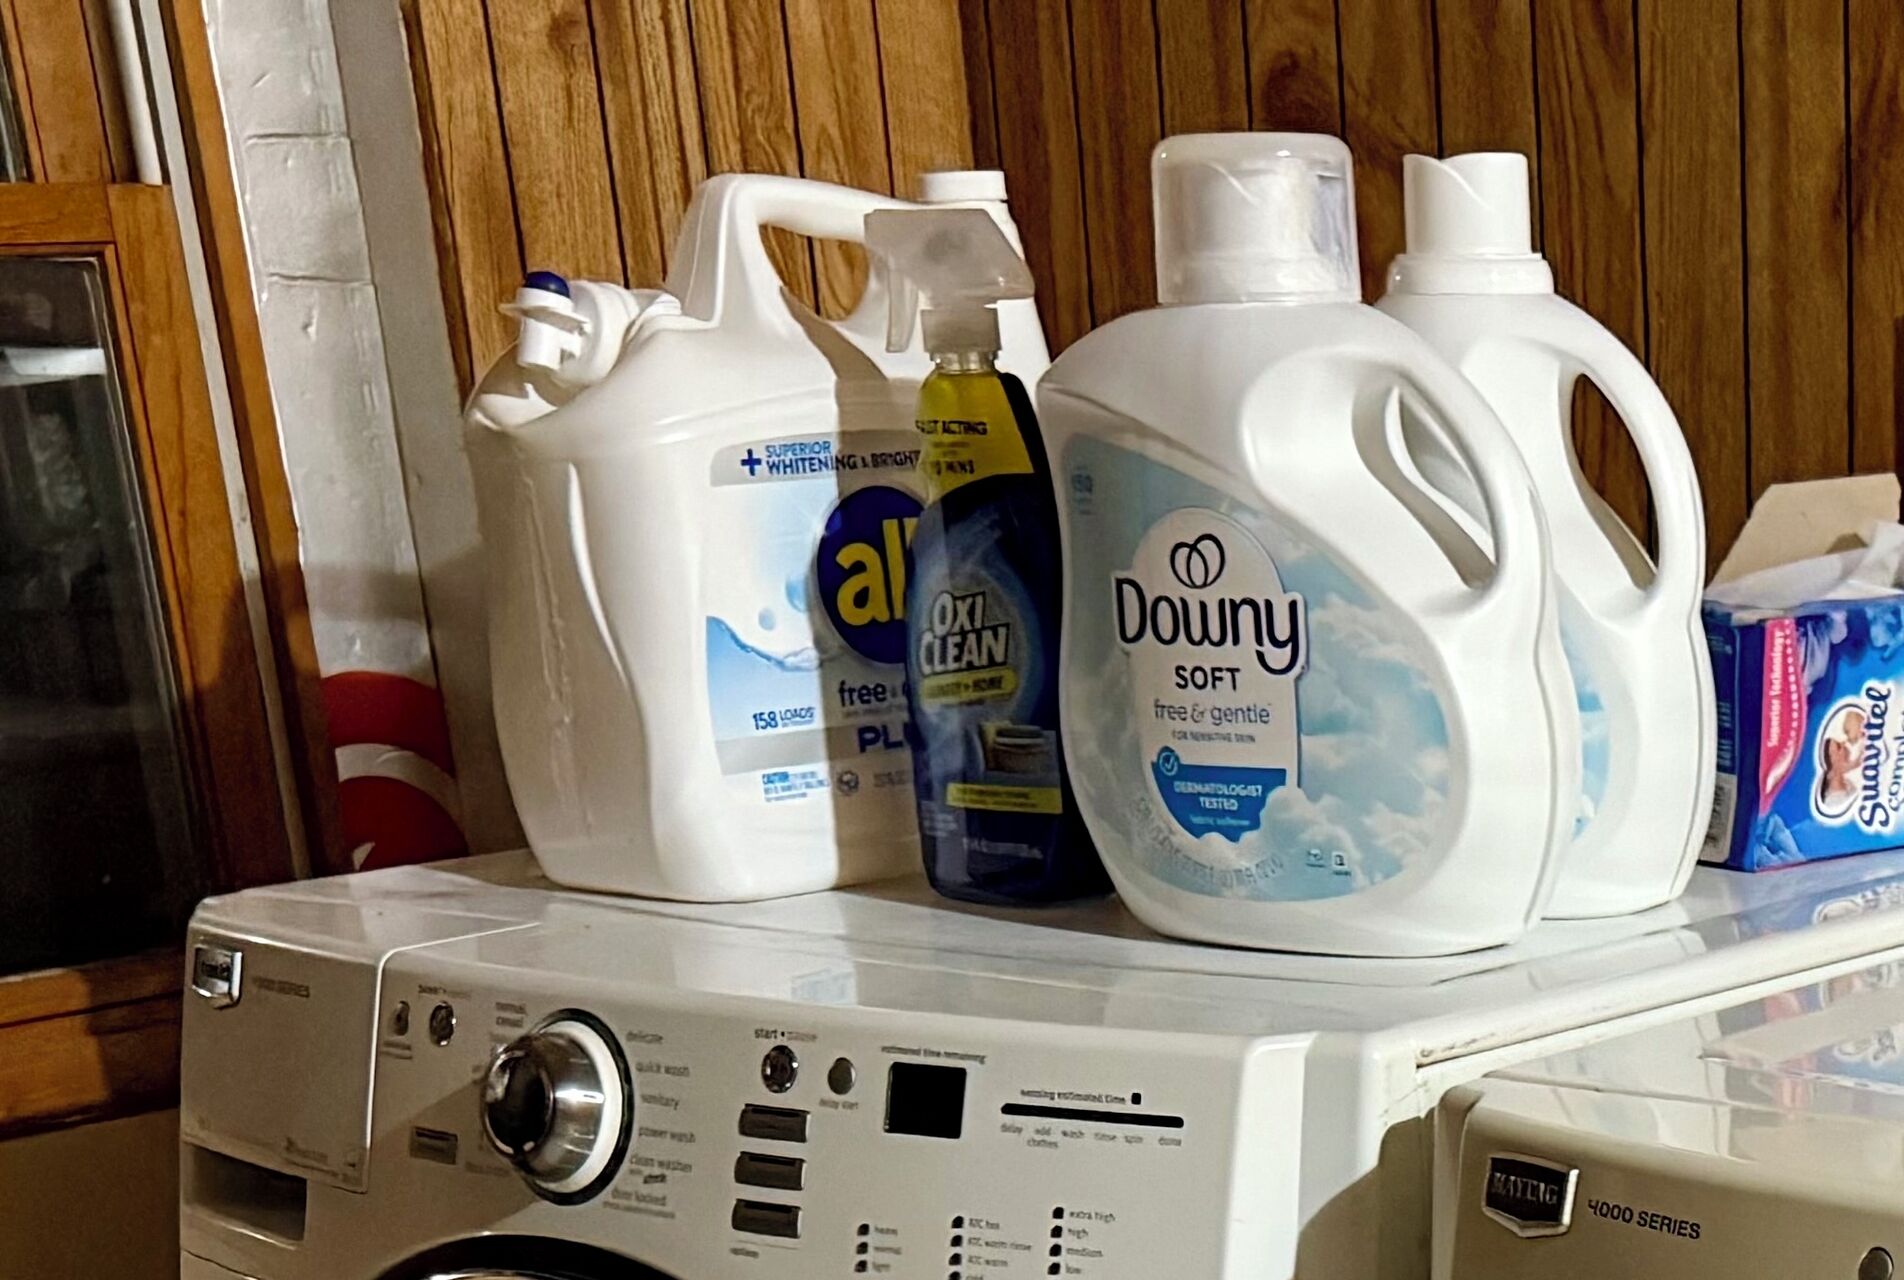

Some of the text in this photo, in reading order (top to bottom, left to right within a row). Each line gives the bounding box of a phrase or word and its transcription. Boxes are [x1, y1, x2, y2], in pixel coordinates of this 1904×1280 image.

[765, 441, 832, 458] SUPERIOR
[765, 453, 858, 476] WHITENING
[931, 590, 986, 637] OXI
[1114, 577, 1300, 676] Downy
[920, 624, 1009, 677] CLEAN
[1174, 664, 1241, 691] SOFT
[1767, 629, 1785, 748] Superior Technology
[838, 679, 887, 708] free
[752, 710, 779, 731] 158
[1154, 699, 1268, 727] free & gentle
[1858, 685, 1892, 828] Suavitel
[1173, 780, 1263, 798] DERMATOLOGIST
[1199, 797, 1239, 811] TESTED
[755, 1028, 778, 1040] start
[1492, 1172, 1560, 1205] MAYTAG
[1587, 1198, 1701, 1241] 4000 SERIES
